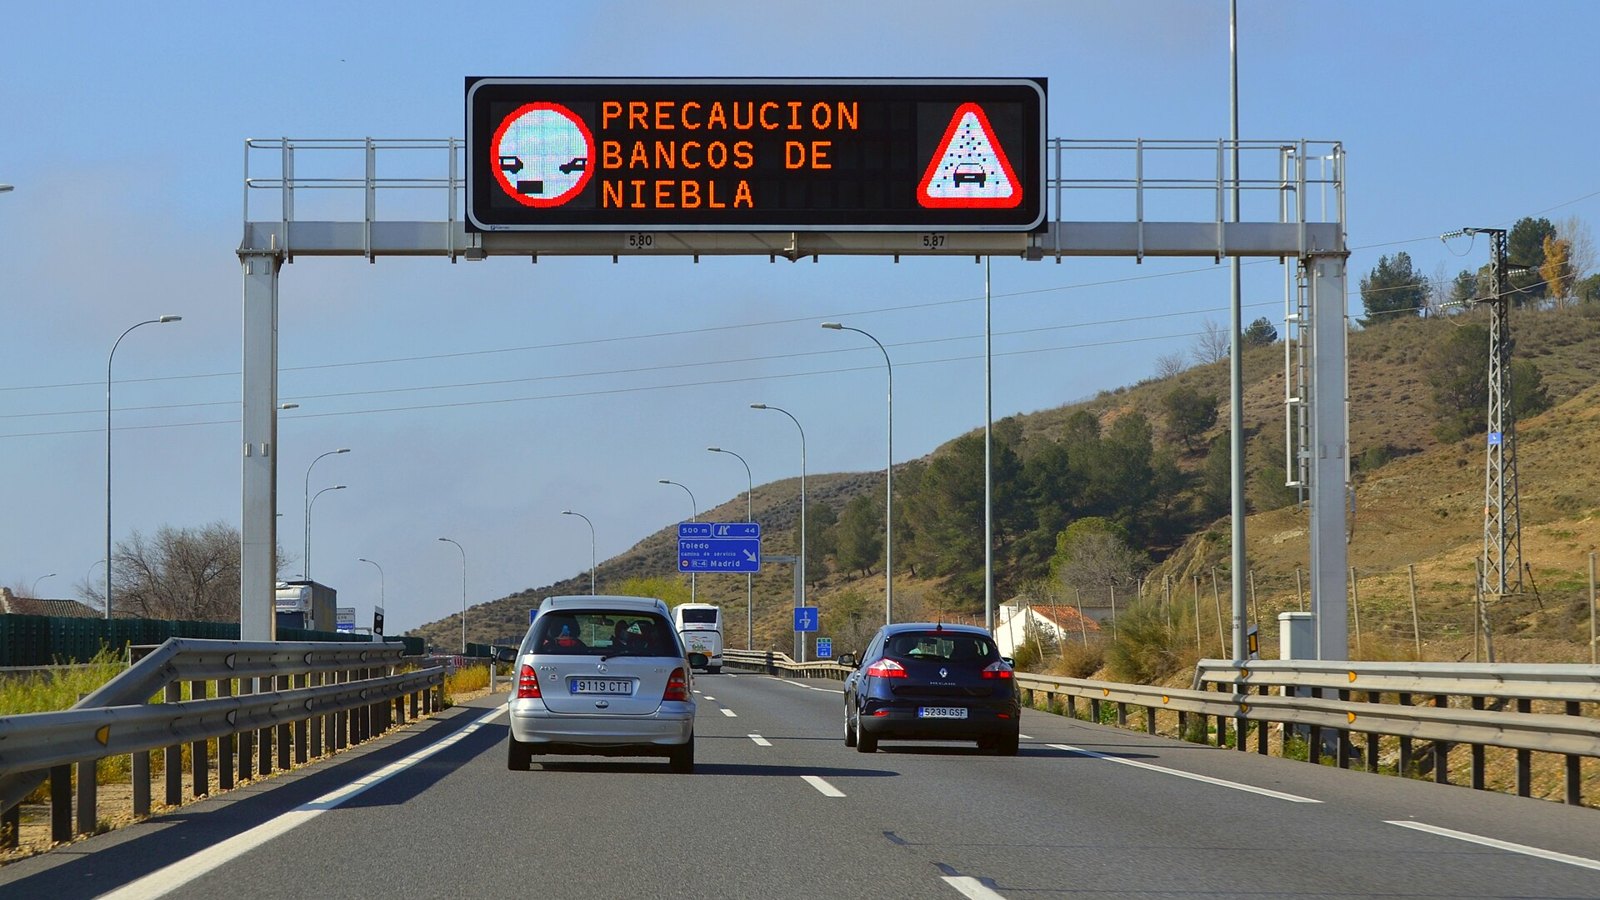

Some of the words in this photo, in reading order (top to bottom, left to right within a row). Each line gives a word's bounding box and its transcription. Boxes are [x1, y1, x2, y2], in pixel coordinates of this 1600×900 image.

[602, 101, 858, 130] PRECAUCION
[602, 140, 754, 169] BANCOS
[785, 140, 832, 169] DE
[602, 180, 754, 209] NIEBLA
[629, 235, 652, 247] 5.80
[923, 235, 945, 247] 5.87
[579, 681, 606, 692] 9119
[609, 681, 630, 692] CTT
[924, 708, 947, 716] 5239
[949, 708, 966, 717] GSF
